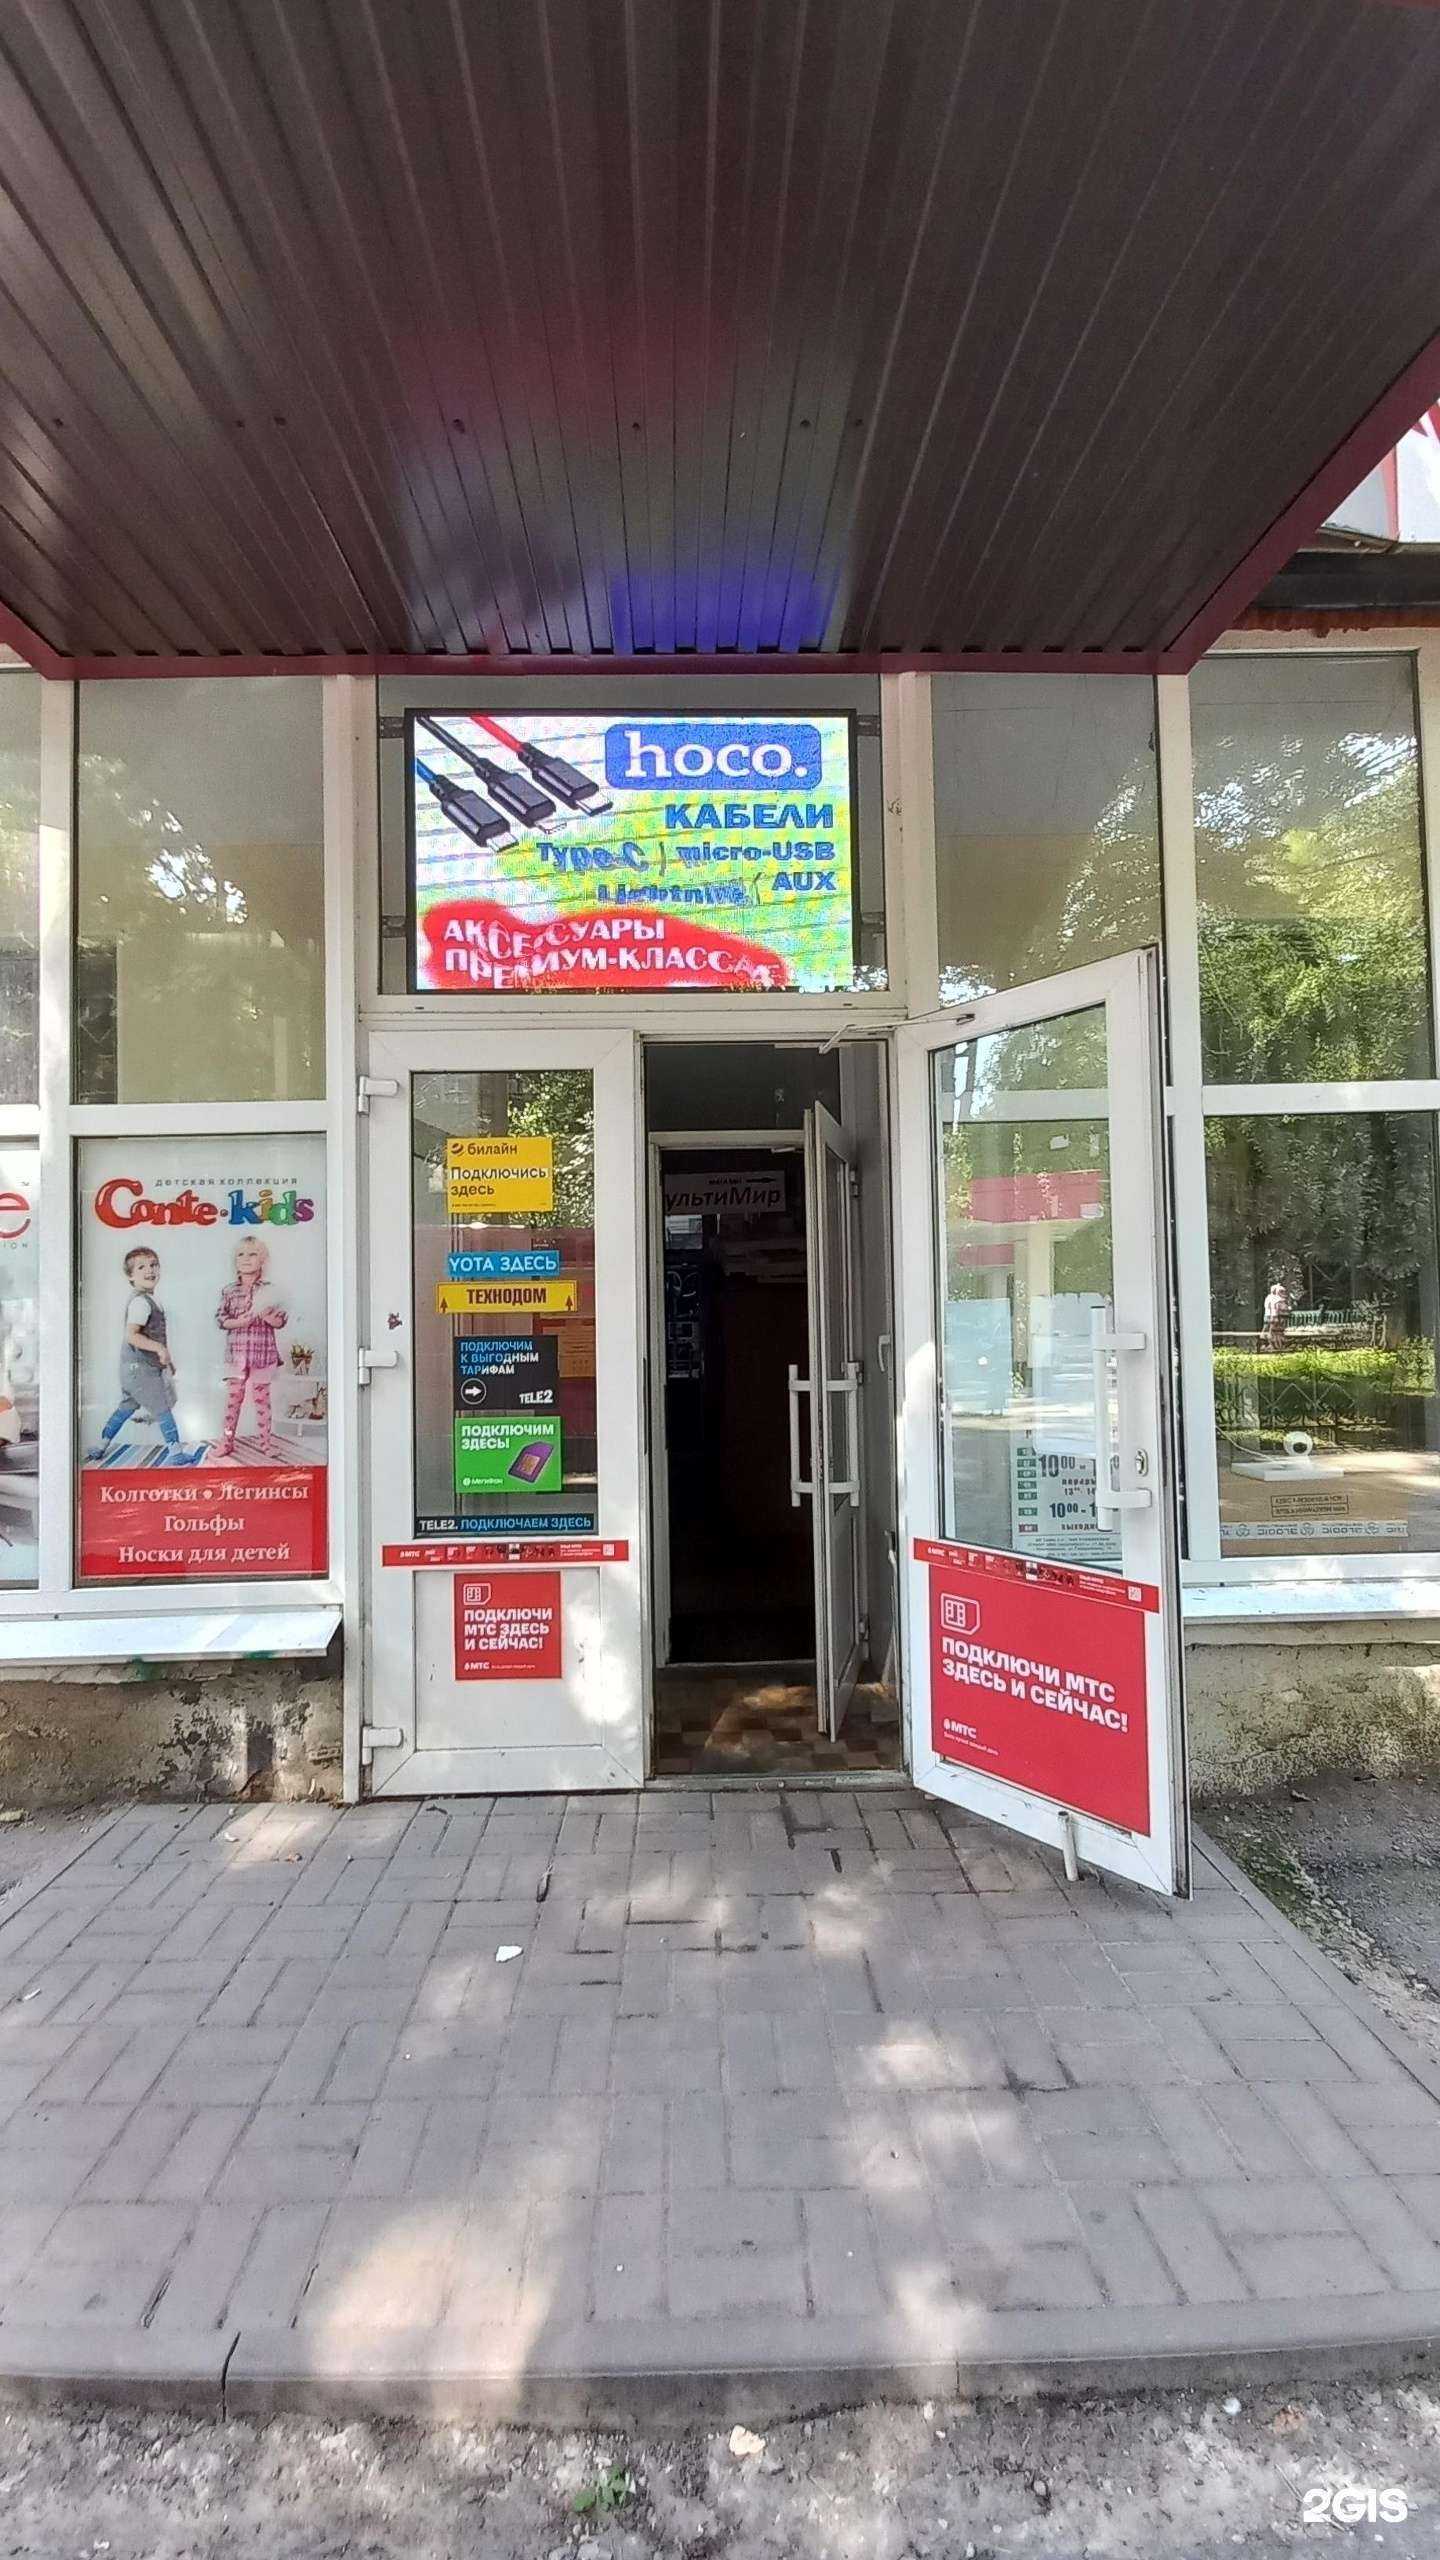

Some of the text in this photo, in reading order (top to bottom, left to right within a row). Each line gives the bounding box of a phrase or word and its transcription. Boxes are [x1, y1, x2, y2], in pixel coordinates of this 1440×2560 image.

[624, 731, 808, 778] hoco.
[665, 803, 833, 829] КАБЕЛИ
[772, 872, 836, 891] AUX
[467, 1143, 517, 1155] билайн
[451, 1166, 546, 1182] Подключись
[155, 1177, 298, 1187] детская коллекция
[451, 1186, 495, 1197] здесь
[665, 1187, 780, 1211] ультиМир
[450, 1256, 557, 1271] YOTA ЗДЕСЬ
[467, 1288, 547, 1305] ТЕХНОДОМ
[460, 1341, 532, 1351] ПОДКЛЮЧИМ
[460, 1352, 538, 1363] К ВЫГОДНЫМ
[461, 1365, 514, 1375] ТАРИФАМ
[519, 1390, 553, 1404] TELE2
[461, 1424, 554, 1437] ПОДКЛЮЧИМ
[100, 1484, 308, 1502] Колготки Легинсы
[163, 1514, 244, 1535] Гольфы
[460, 1518, 549, 1531] ПОДКЛЮЧАЕМ
[551, 1517, 591, 1529] ЗДЕСЬ
[118, 1542, 290, 1563] Носки для детей
[464, 1608, 552, 1621] ПОДКЛЮЧИ
[464, 1623, 549, 1636] МТС ЗДЕСЬ
[464, 1636, 543, 1650] И СЕЙЧАС!
[470, 1662, 489, 1670] МТС
[942, 1636, 1115, 1703] ПОДКЛЮЧИ МТС
[942, 1658, 1128, 1733] ЗДЕСЬ И СЕЙЧАС!
[951, 1720, 977, 1739] МТС
